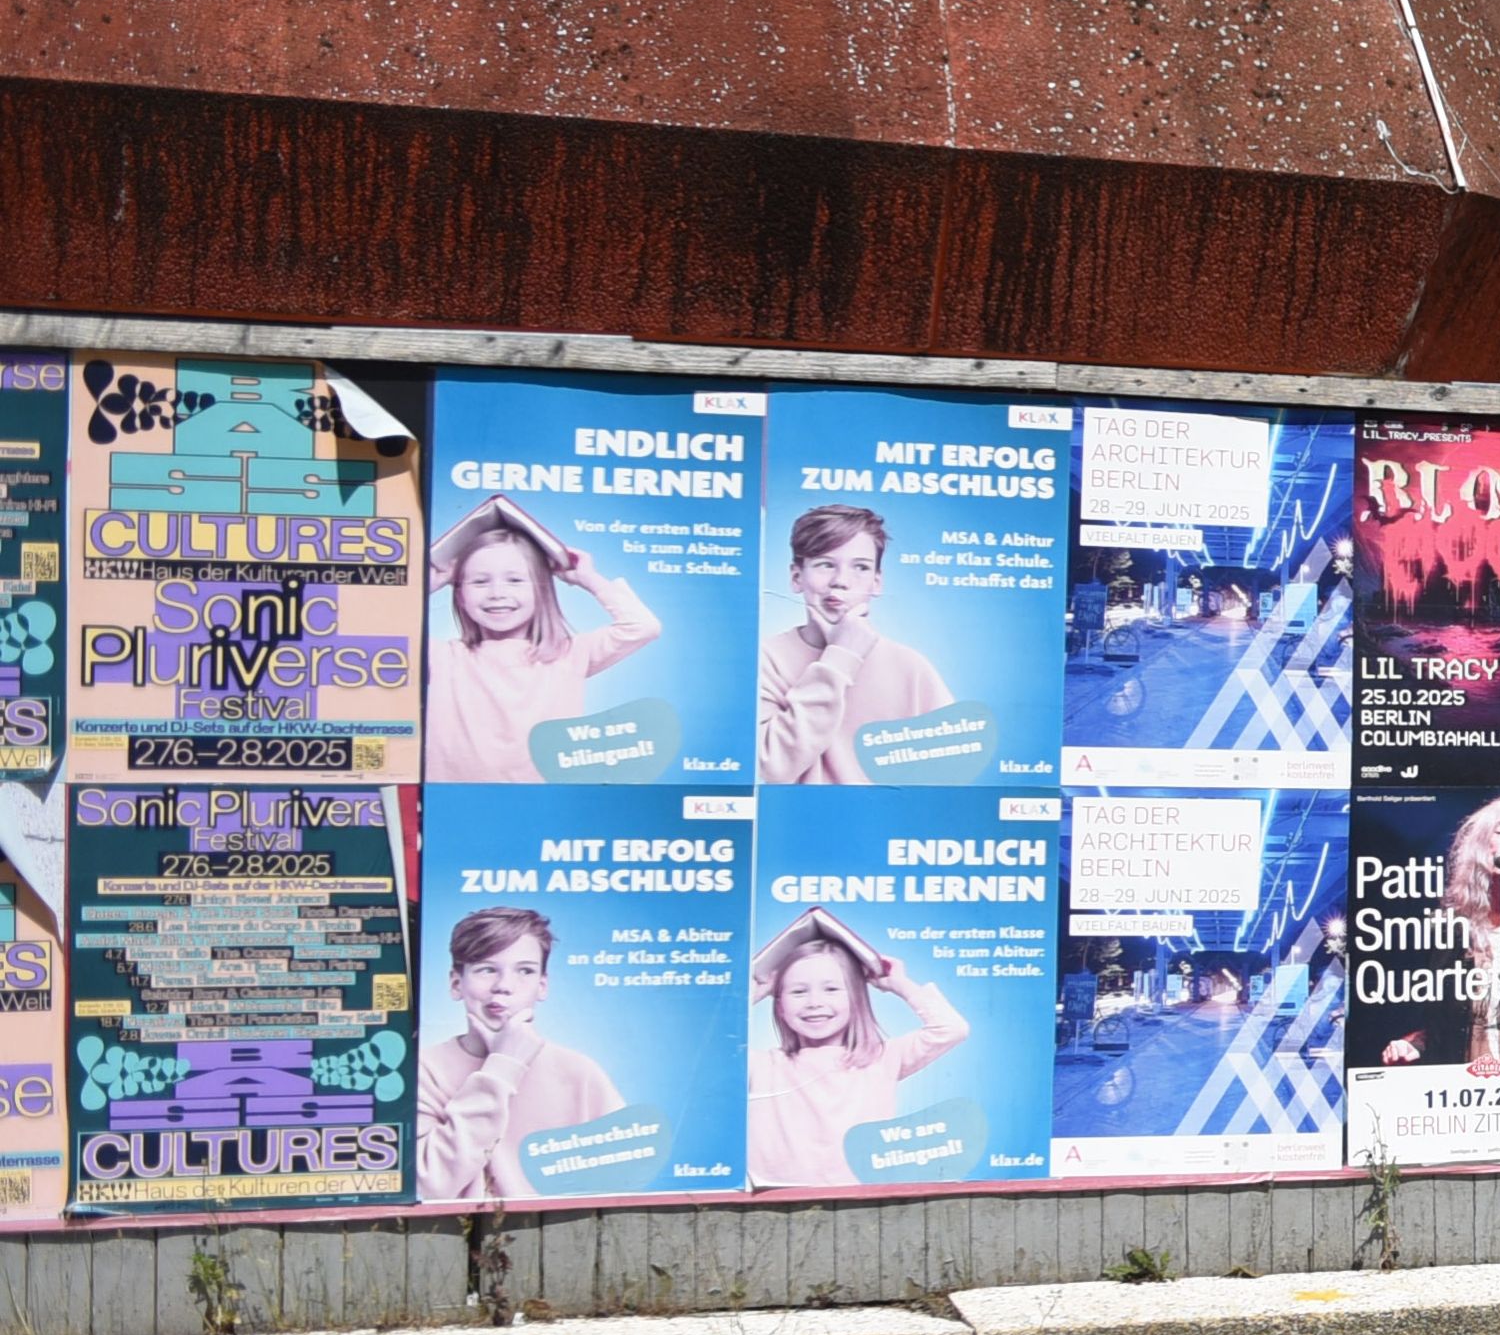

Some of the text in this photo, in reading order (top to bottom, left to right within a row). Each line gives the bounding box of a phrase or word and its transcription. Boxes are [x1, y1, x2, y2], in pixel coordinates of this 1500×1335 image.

[1094, 417, 1190, 439] TAG DER
[575, 429, 744, 461] ENDLICH
[875, 441, 1055, 470] MIT ERFOLG
[1092, 444, 1260, 468] ARCHITEKTUR
[451, 461, 743, 498] GERNE LERNEN
[801, 468, 1054, 499] ZUM ABSCHLUSS
[1092, 470, 1180, 491] BERLIN
[1156, 501, 1201, 517] JUNI
[1208, 504, 1250, 520] 2025
[90, 513, 404, 562] CULTURES
[941, 531, 1054, 547] MSA & Abitur
[901, 551, 1053, 568] an der Klax Schule.
[141, 564, 194, 581] Haus
[198, 565, 233, 582] der
[321, 567, 358, 584] der
[360, 568, 407, 585] Welt
[926, 573, 1052, 589] Du schaffst das!
[152, 577, 338, 636] Sonic
[82, 626, 408, 689] Pluriverse
[1361, 657, 1499, 681] LIL TRACY
[178, 689, 311, 721] Festival
[1361, 689, 1465, 706] 25.10.2025
[1361, 710, 1431, 726] BERLIN
[567, 722, 636, 741] We are
[558, 741, 654, 769] bilingual!
[683, 757, 740, 772] klax.de
[193, 828, 297, 851] Festival
[541, 839, 734, 862] MIT ERFOLG
[888, 839, 1046, 865] ENDLICH
[460, 870, 734, 893] ZUM ABSCHLUSS
[772, 876, 1045, 902] GERNE LERNEN
[1356, 856, 1444, 899] Patti
[1355, 908, 1469, 952] Smith
[1397, 1113, 1466, 1137] BERLIN
[83, 1126, 398, 1178] CULTURES
